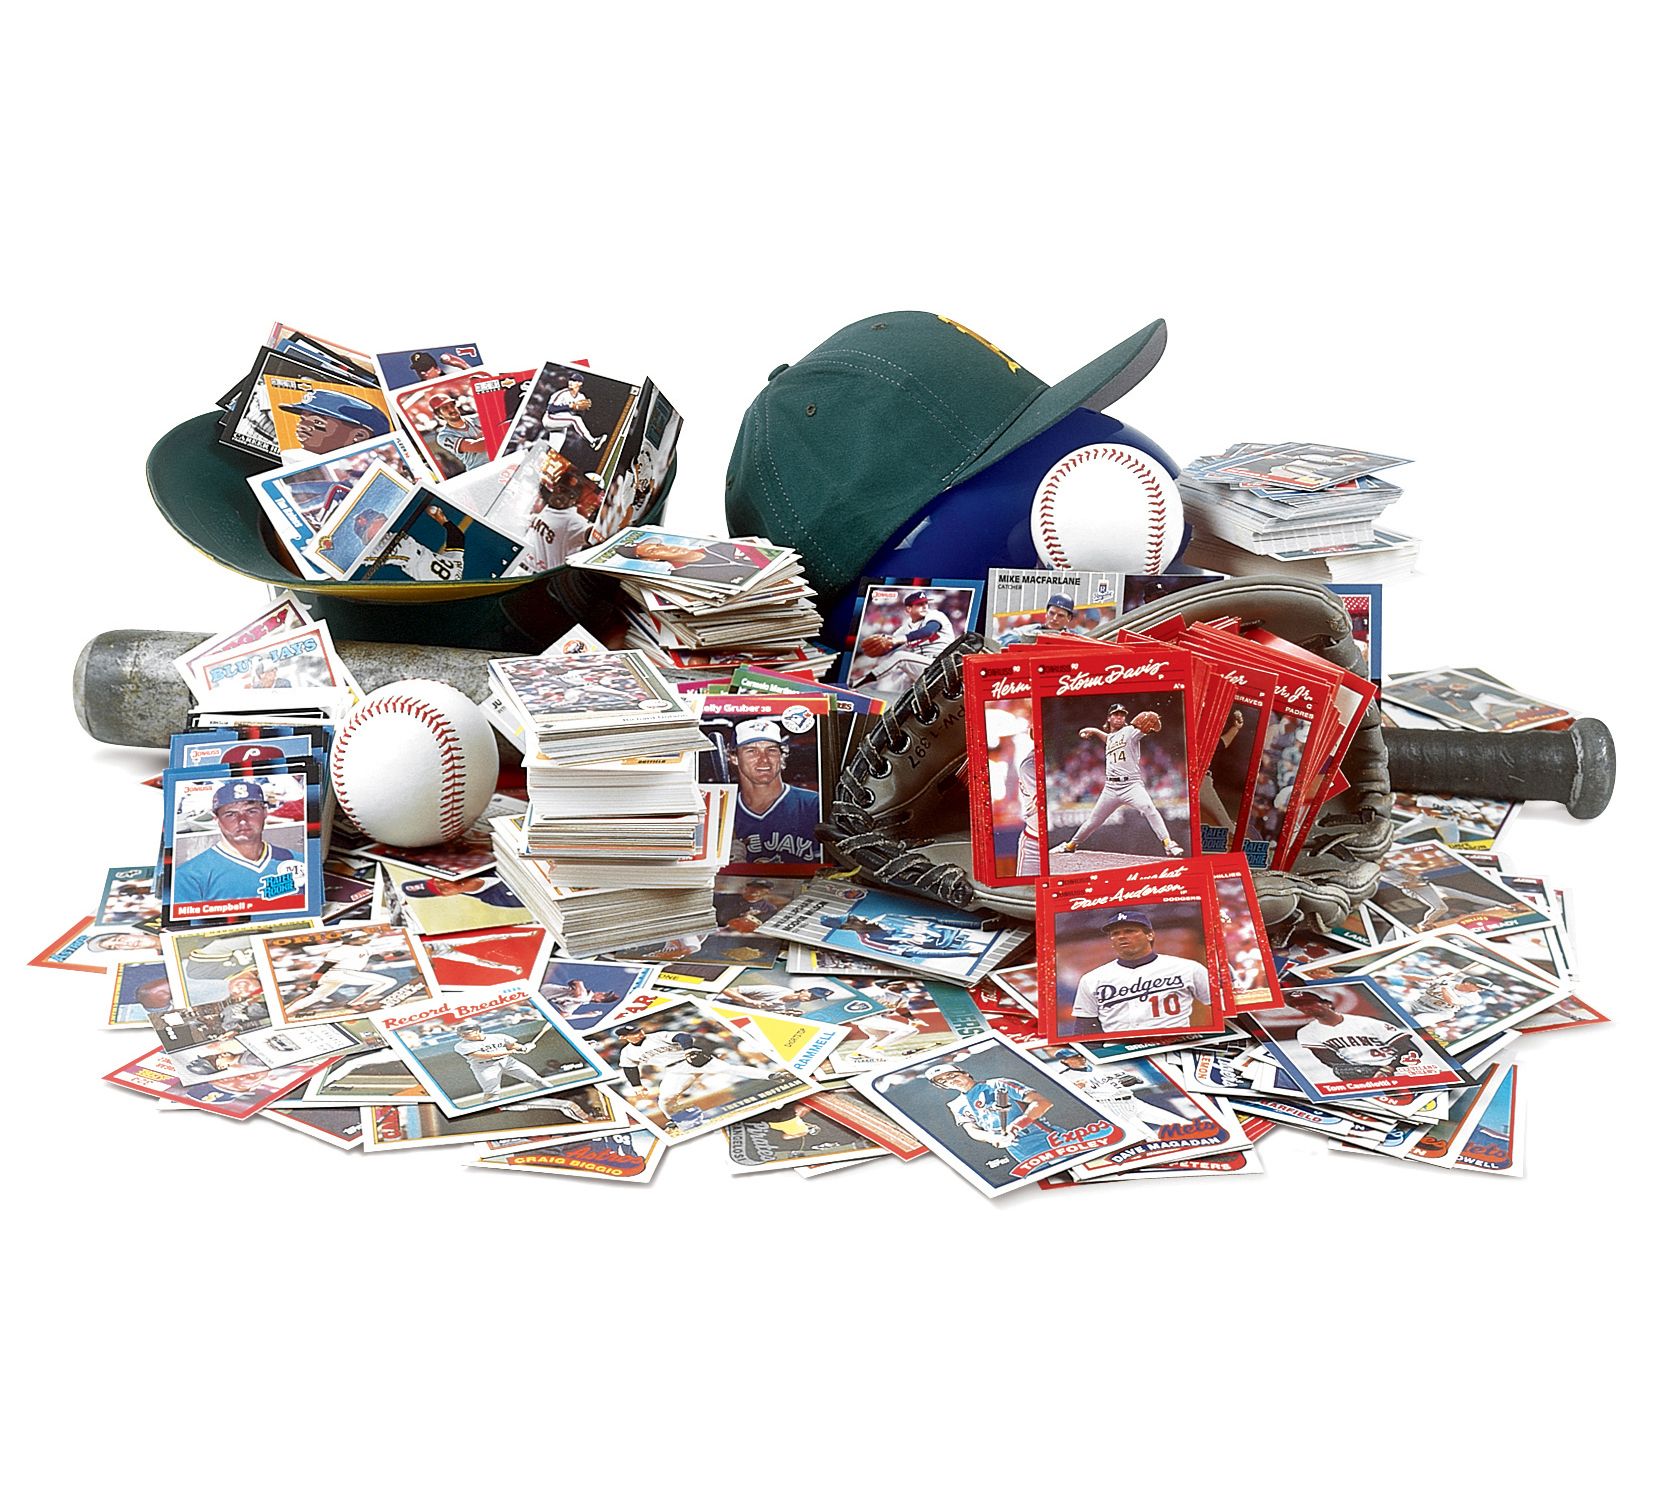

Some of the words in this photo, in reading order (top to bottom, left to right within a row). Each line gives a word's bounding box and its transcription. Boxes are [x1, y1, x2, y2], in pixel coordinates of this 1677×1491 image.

[998, 575, 1020, 583] MIKE
[1022, 576, 1081, 586] MACFARLANE
[269, 638, 318, 662] JAYS
[1056, 672, 1105, 696] Storm
[1105, 659, 1169, 684] Davis
[724, 703, 760, 713] Gruber
[1234, 694, 1263, 706] BRAVES
[1285, 706, 1314, 719] PADRES
[1112, 750, 1127, 764] 14
[233, 784, 249, 799] S
[1202, 839, 1226, 849] OOKIE
[1069, 895, 1107, 910] Dave
[1109, 884, 1185, 902] Anderson
[178, 906, 200, 915] Mike
[202, 902, 246, 913] Campbell
[1096, 975, 1184, 1004] Dodgers
[382, 1003, 451, 1029] Record
[455, 990, 529, 1017] Breaker
[1148, 993, 1181, 1018] 10
[757, 1079, 804, 1098] HOFFMAN
[1323, 1084, 1346, 1093] Tom
[1347, 1080, 1391, 1091] Candiotti
[1260, 1100, 1324, 1123] BARFIELD
[1047, 1120, 1110, 1147] Expos
[1159, 1118, 1216, 1138] Mets
[1019, 1153, 1055, 1174] TOM
[1056, 1137, 1110, 1157] FOLEY
[1111, 1145, 1147, 1164] DAVE
[1147, 1137, 1221, 1152] MAGADAN
[514, 1156, 561, 1165] CRAIG
[569, 1160, 624, 1176] BIGGIO
